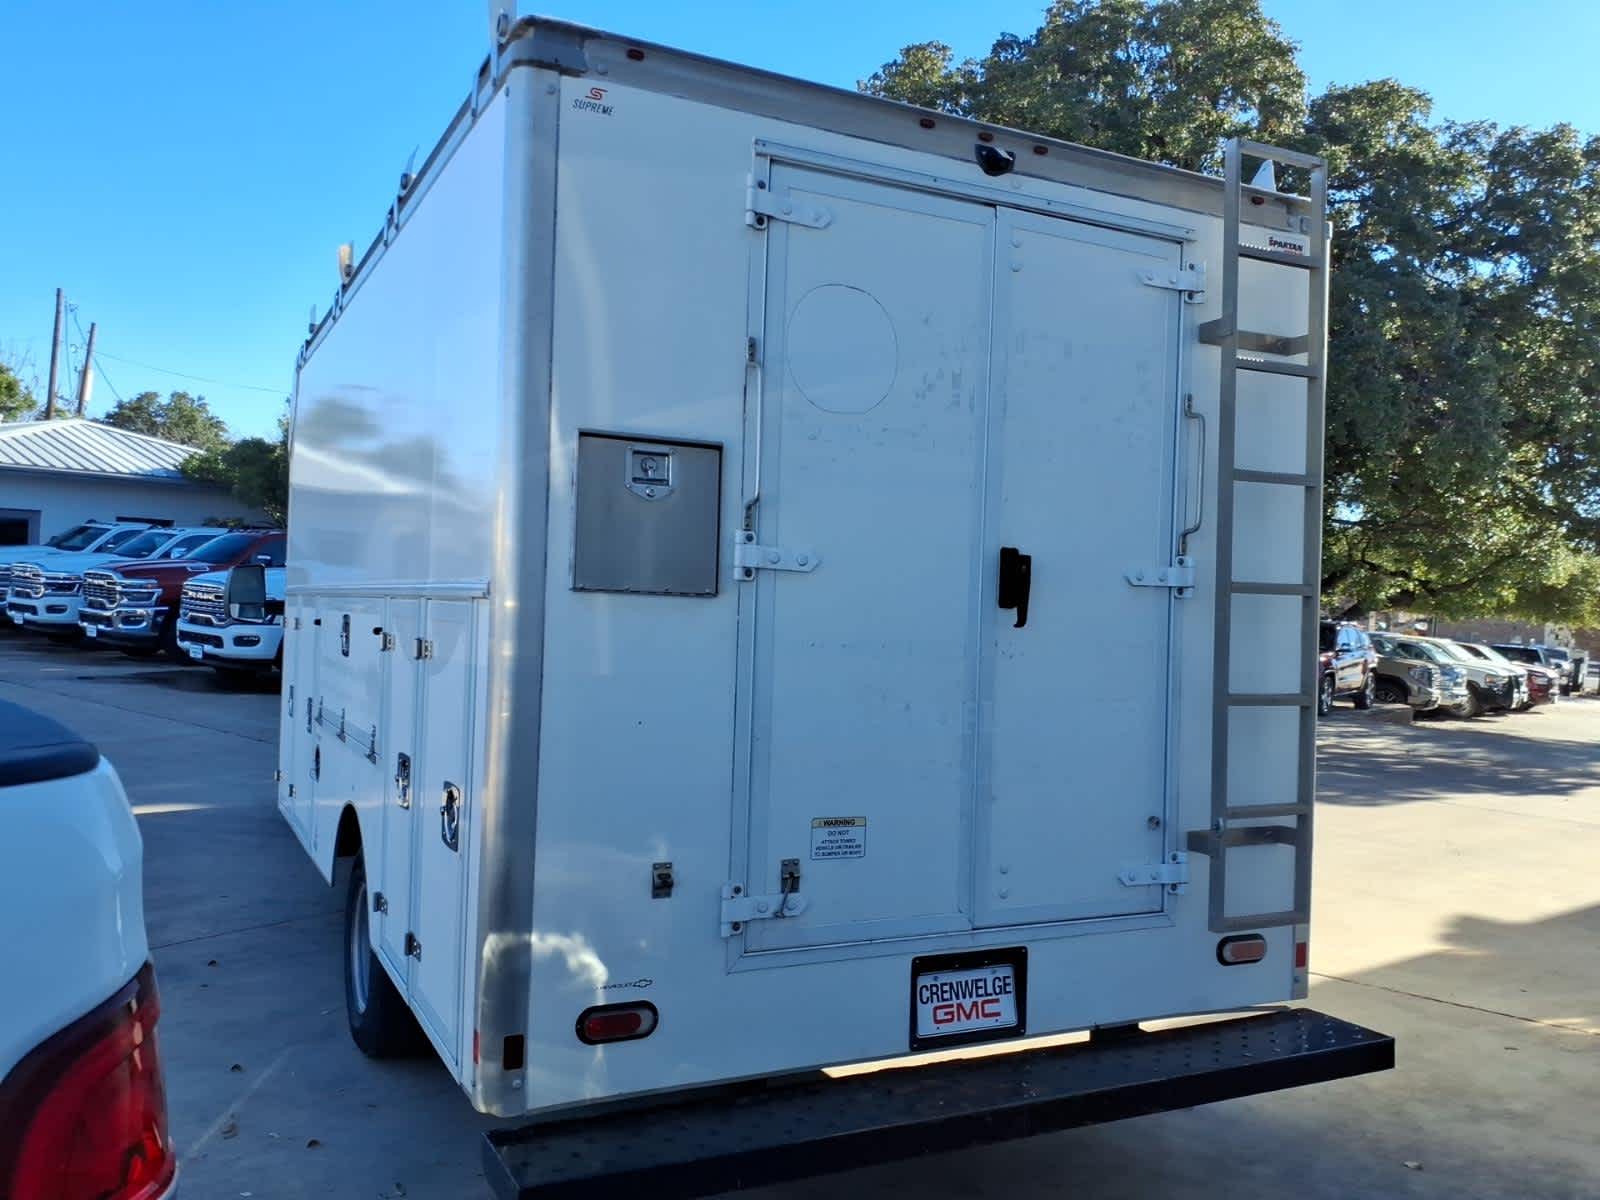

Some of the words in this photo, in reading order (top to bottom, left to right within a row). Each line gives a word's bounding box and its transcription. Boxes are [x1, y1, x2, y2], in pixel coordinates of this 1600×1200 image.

[572, 98, 614, 116] SUPREME
[1268, 237, 1304, 251] SPARTAN
[823, 818, 856, 827] WARNING
[919, 976, 1013, 1005] CRENWELGE
[932, 998, 1002, 1025] GMC
